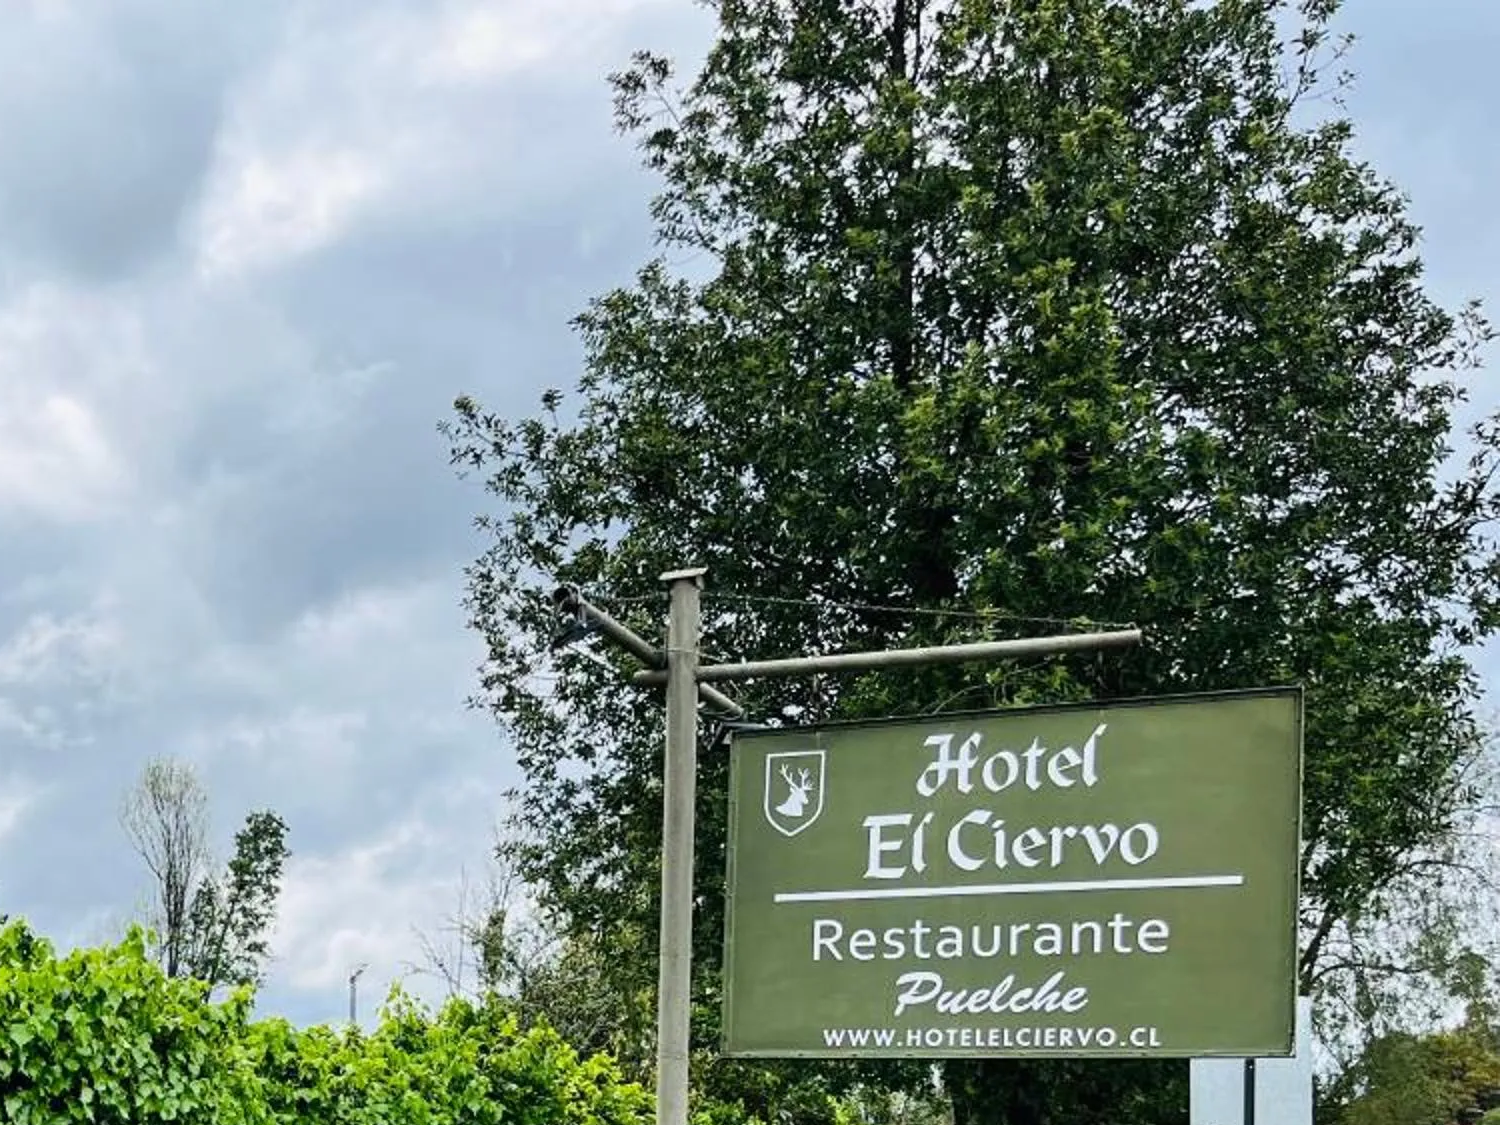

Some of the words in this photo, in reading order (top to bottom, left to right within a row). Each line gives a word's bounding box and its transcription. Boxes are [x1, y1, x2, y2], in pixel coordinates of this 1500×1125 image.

[916, 724, 1108, 797] Hotel
[862, 811, 931, 879] El
[947, 809, 1160, 871] Ciervo
[812, 912, 1170, 961] Restaurante
[894, 970, 1090, 1017] Puelche
[822, 1026, 1163, 1048] WWW.HOTELELCIERVO.CL
